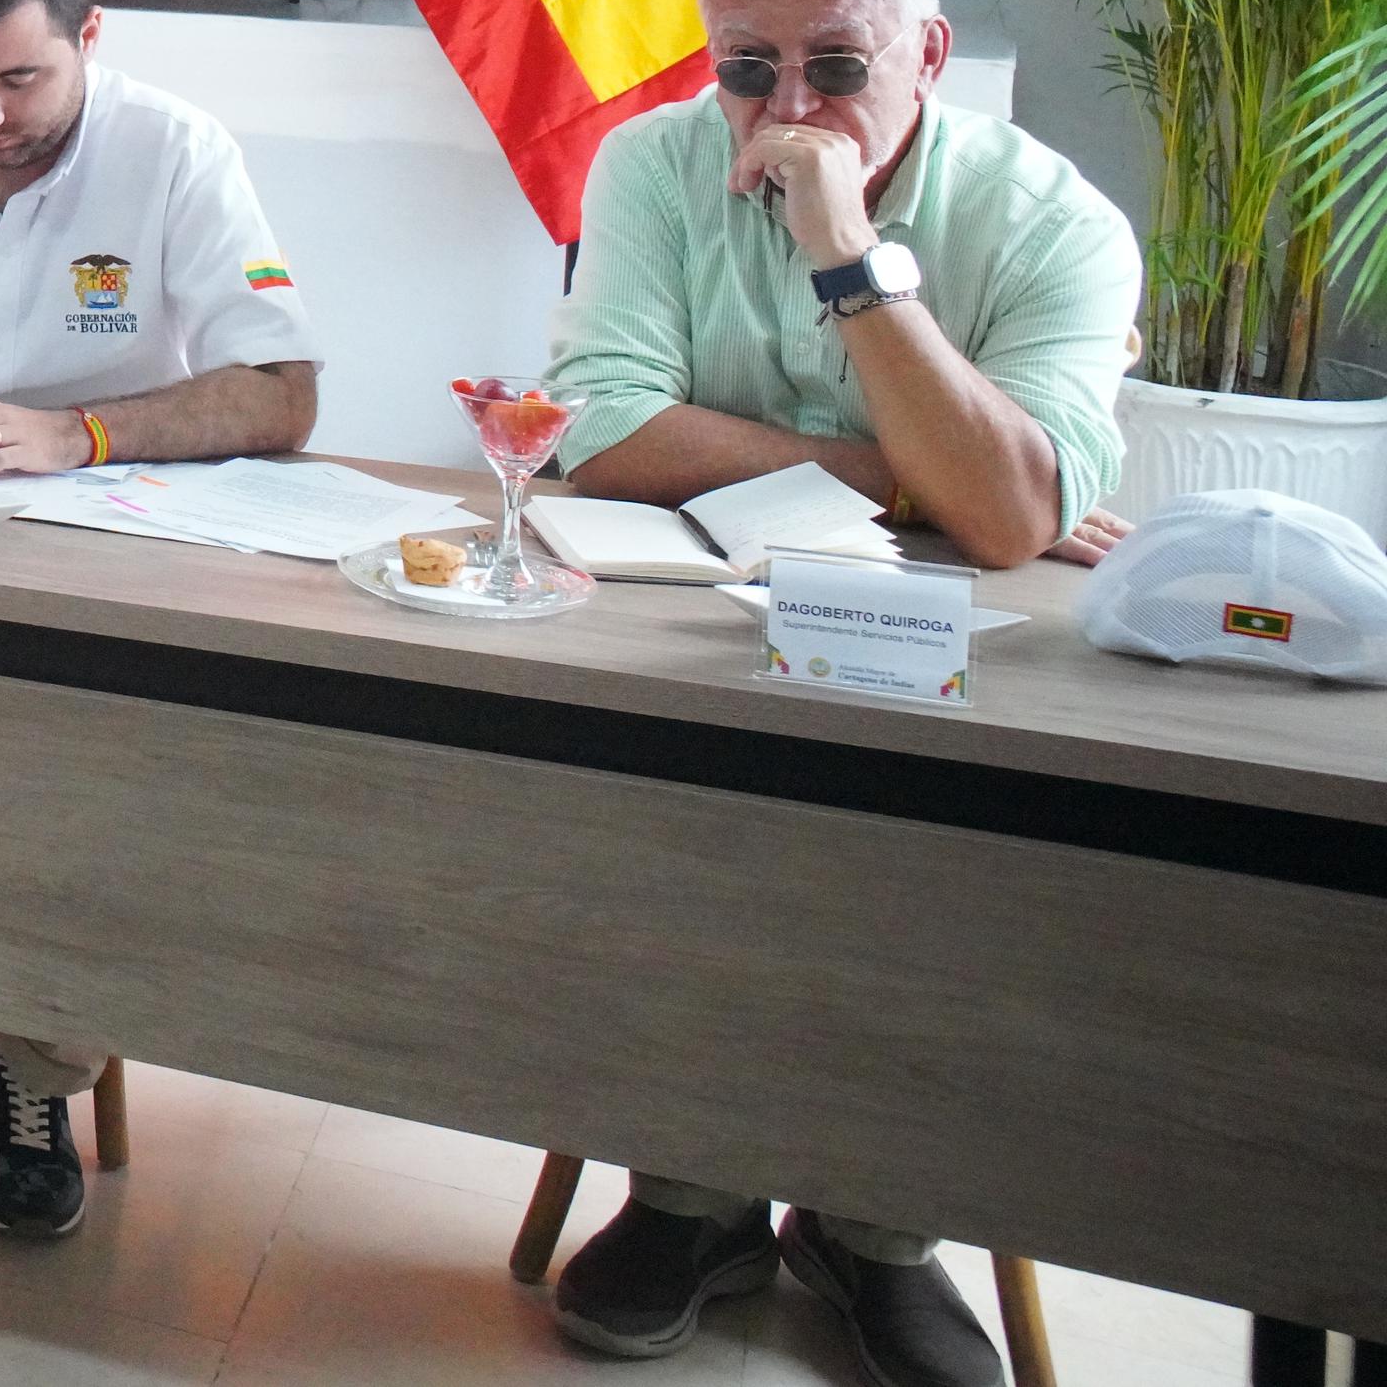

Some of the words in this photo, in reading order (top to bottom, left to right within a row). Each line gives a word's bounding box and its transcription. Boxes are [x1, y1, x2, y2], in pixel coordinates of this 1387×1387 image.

[65, 311, 138, 323] GOBERNACIÓN
[80, 322, 138, 333] BOLIVAR
[778, 600, 875, 624] DAGOBERTO
[880, 614, 955, 634] QUIROGA
[783, 619, 858, 637] Superintendente
[861, 629, 904, 643] Servicios
